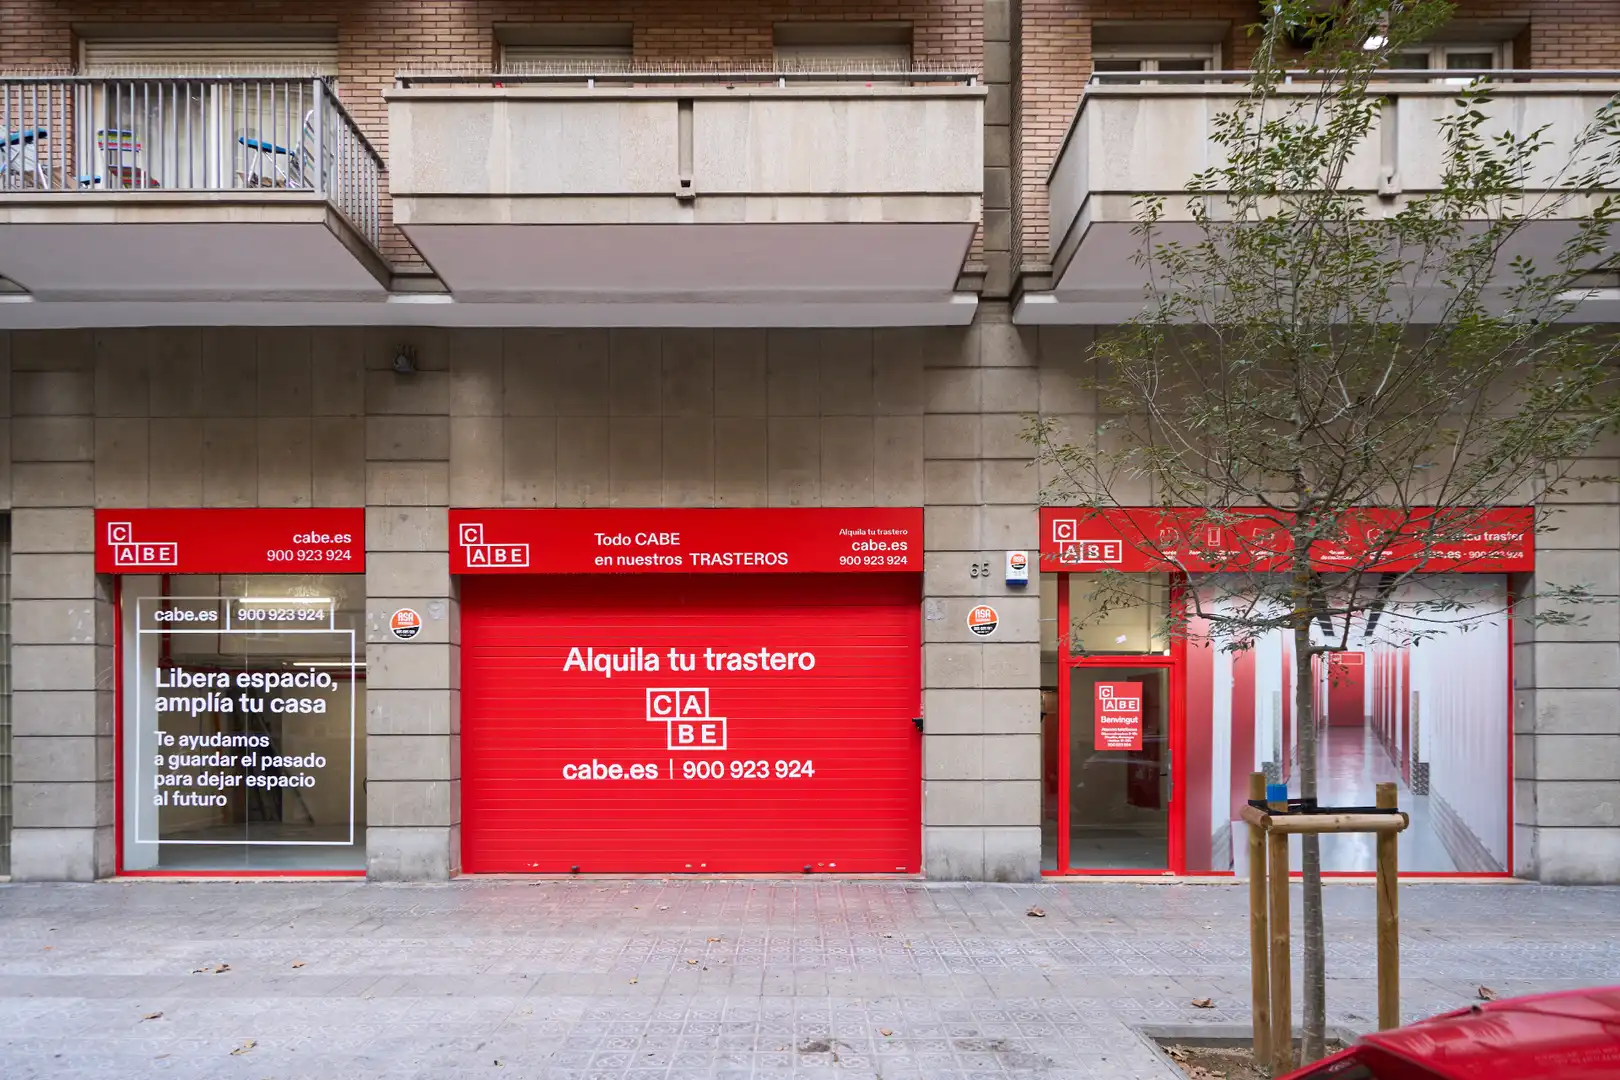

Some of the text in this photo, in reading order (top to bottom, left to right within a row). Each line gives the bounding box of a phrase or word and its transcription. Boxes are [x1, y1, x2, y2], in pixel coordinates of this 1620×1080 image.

[292, 531, 352, 543] cabe.es
[839, 528, 908, 537] Alquila tu trastero
[594, 533, 680, 546] Todo CABE
[851, 539, 908, 551] cabe.es
[267, 550, 352, 561] 900 923 924
[595, 553, 789, 566] en nuestros TRASTEROS
[839, 556, 908, 565] 900 923 924
[1469, 550, 1487, 559] 900
[970, 563, 990, 577] 65
[154, 608, 218, 622] cabe.es
[238, 609, 325, 621] 900 923 924
[562, 647, 816, 679] Alquila tu trastero
[155, 668, 338, 692] Libera espacio,
[155, 692, 327, 717] amplía tu casa
[1100, 716, 1138, 725] Benvingut
[154, 731, 270, 751] Te ayudamos
[154, 752, 327, 771] a guardar el pasado
[562, 759, 815, 780] cabe.es 900 923 924
[154, 772, 315, 791] para dejar espacio
[153, 791, 227, 807] al futuro
